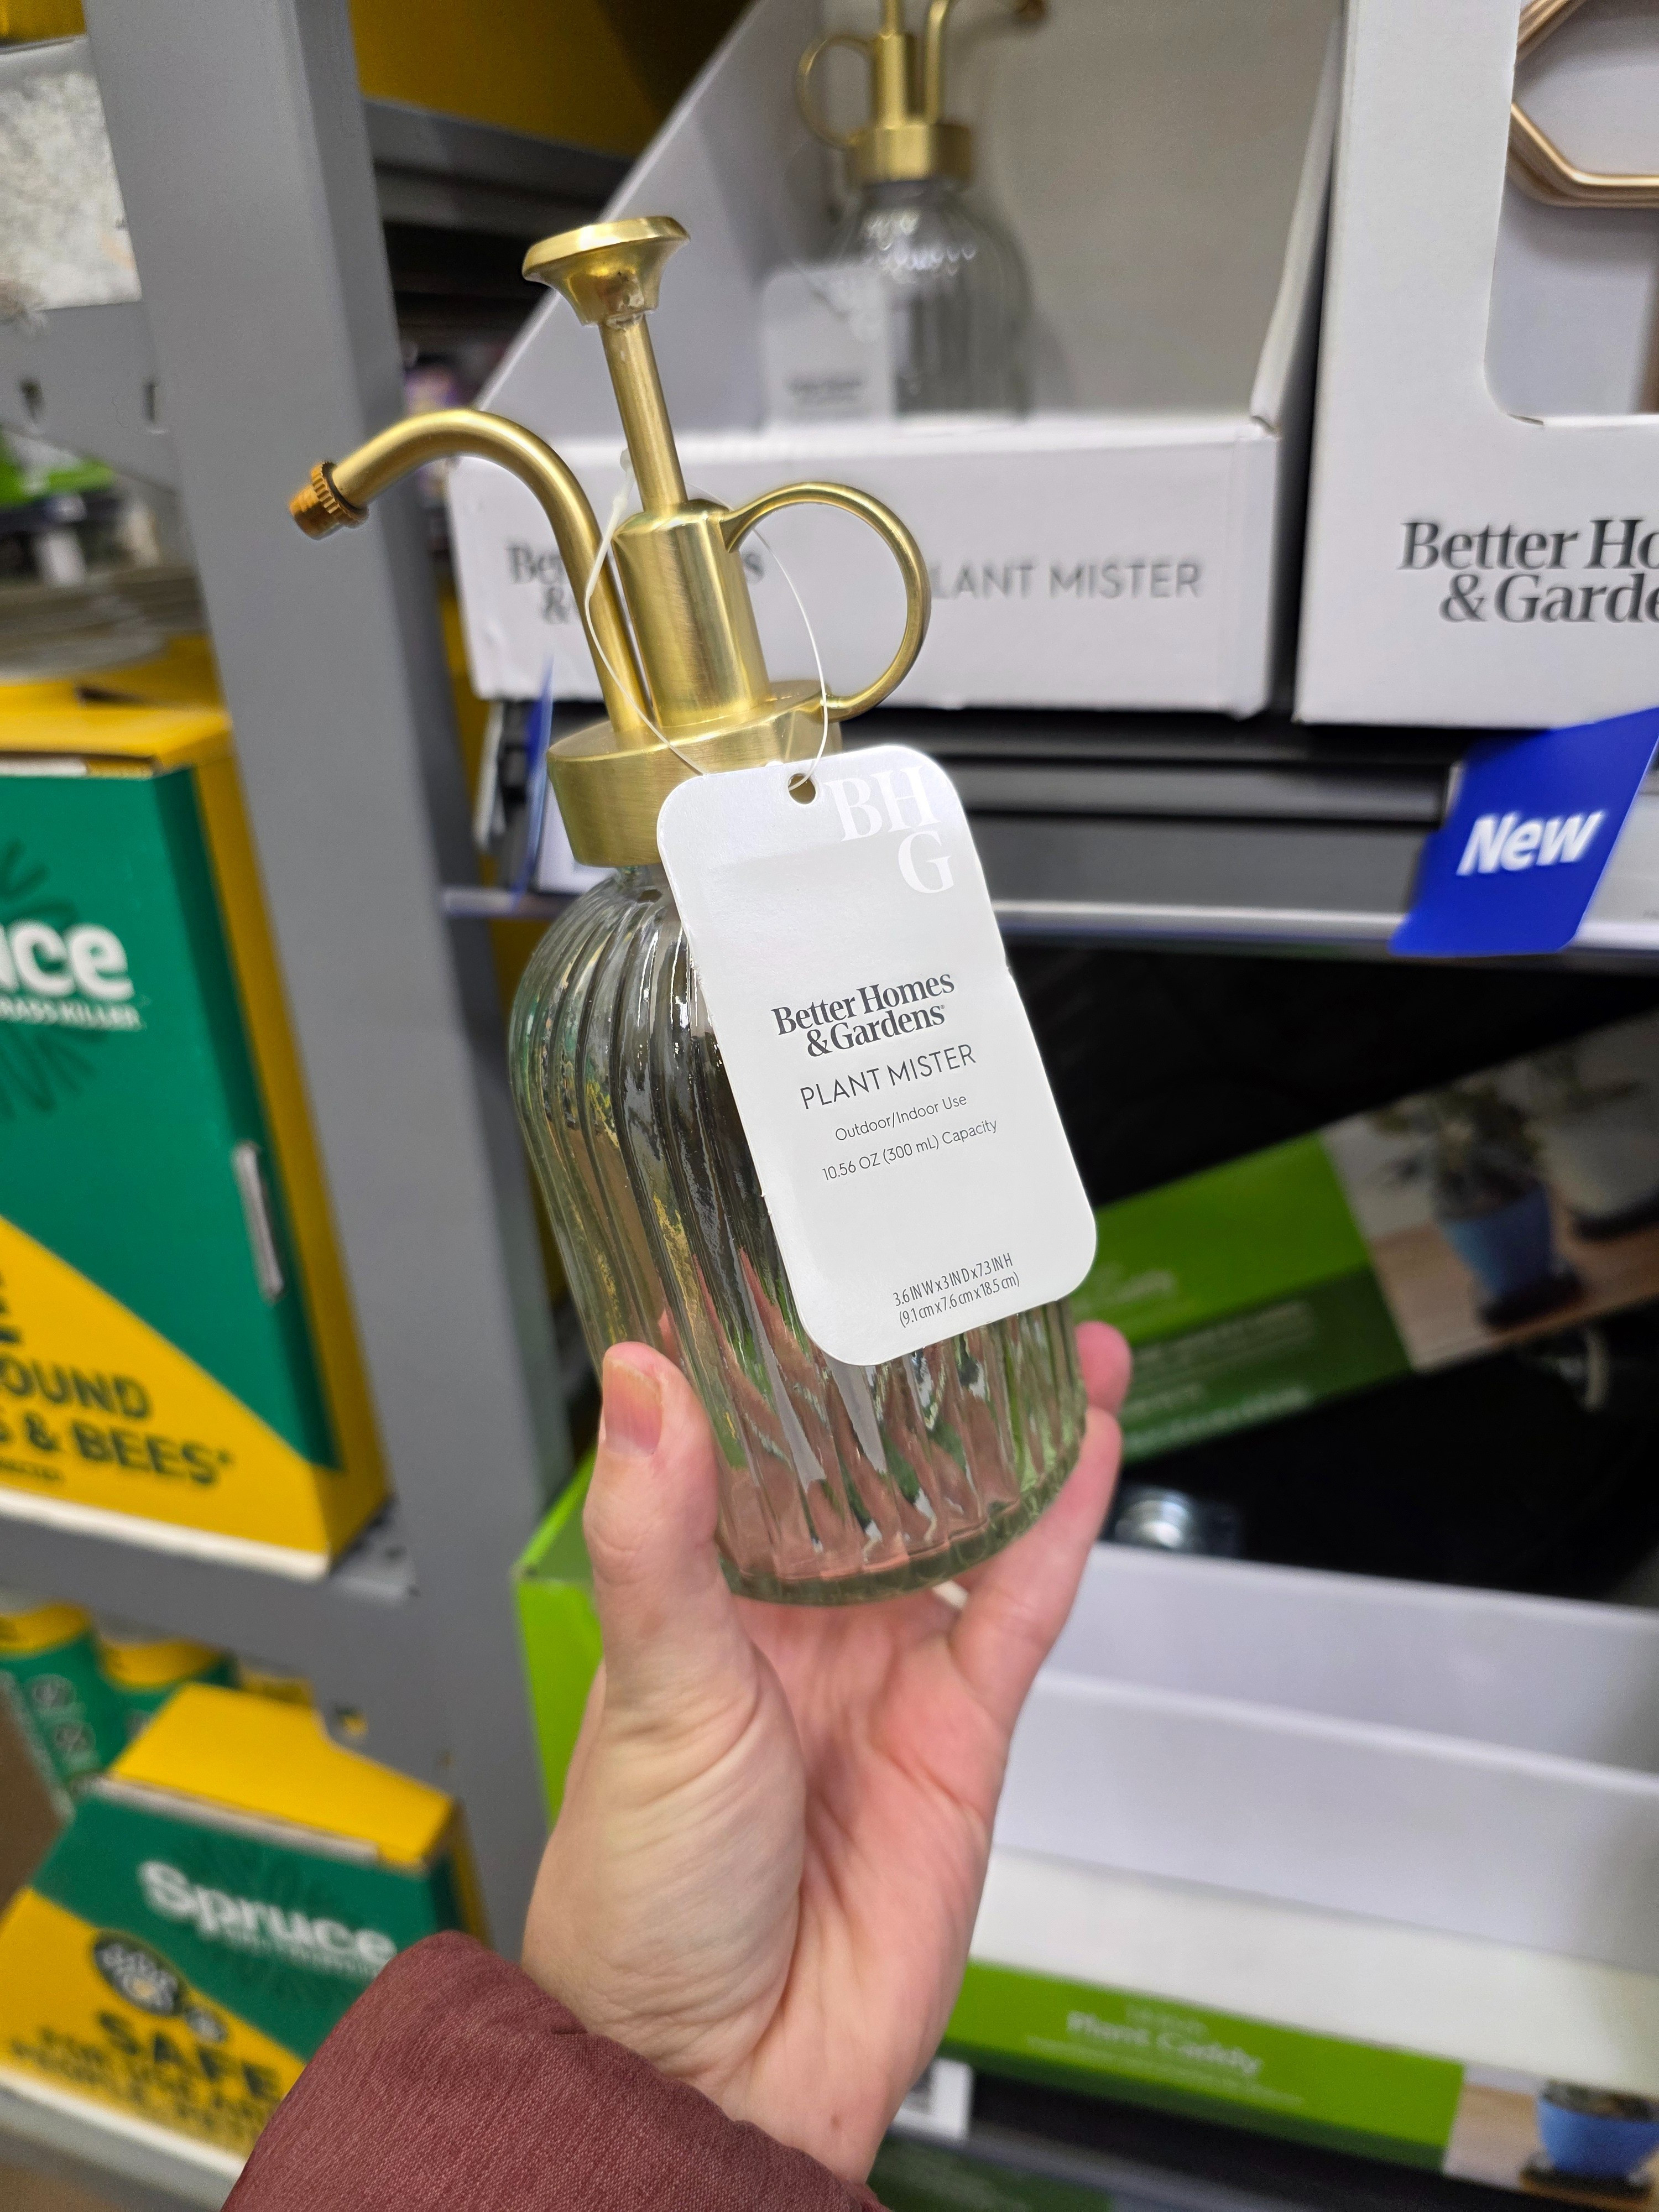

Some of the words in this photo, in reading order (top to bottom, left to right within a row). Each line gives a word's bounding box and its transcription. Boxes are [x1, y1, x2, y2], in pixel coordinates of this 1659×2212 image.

[1396, 521, 1580, 570] Better
[928, 563, 1034, 599] LANT
[1049, 561, 1204, 599] MISTER
[898, 831, 954, 894] G
[1457, 810, 1605, 877] New
[771, 996, 857, 1036] Better
[856, 974, 954, 1014] Homes
[800, 1068, 880, 1110] PLANT
[886, 1044, 977, 1086] MISTER
[835, 1103, 939, 1141] Outdoor/Indoor
[942, 1095, 967, 1110] Use
[822, 1160, 857, 1181] 10.56
[859, 1152, 881, 1169] OZ
[883, 1143, 912, 1165] (300
[916, 1134, 940, 1153] mL)
[942, 1119, 997, 1145] Capacity
[23, 1411, 58, 1452] &
[138, 1861, 397, 1965] Spruce
